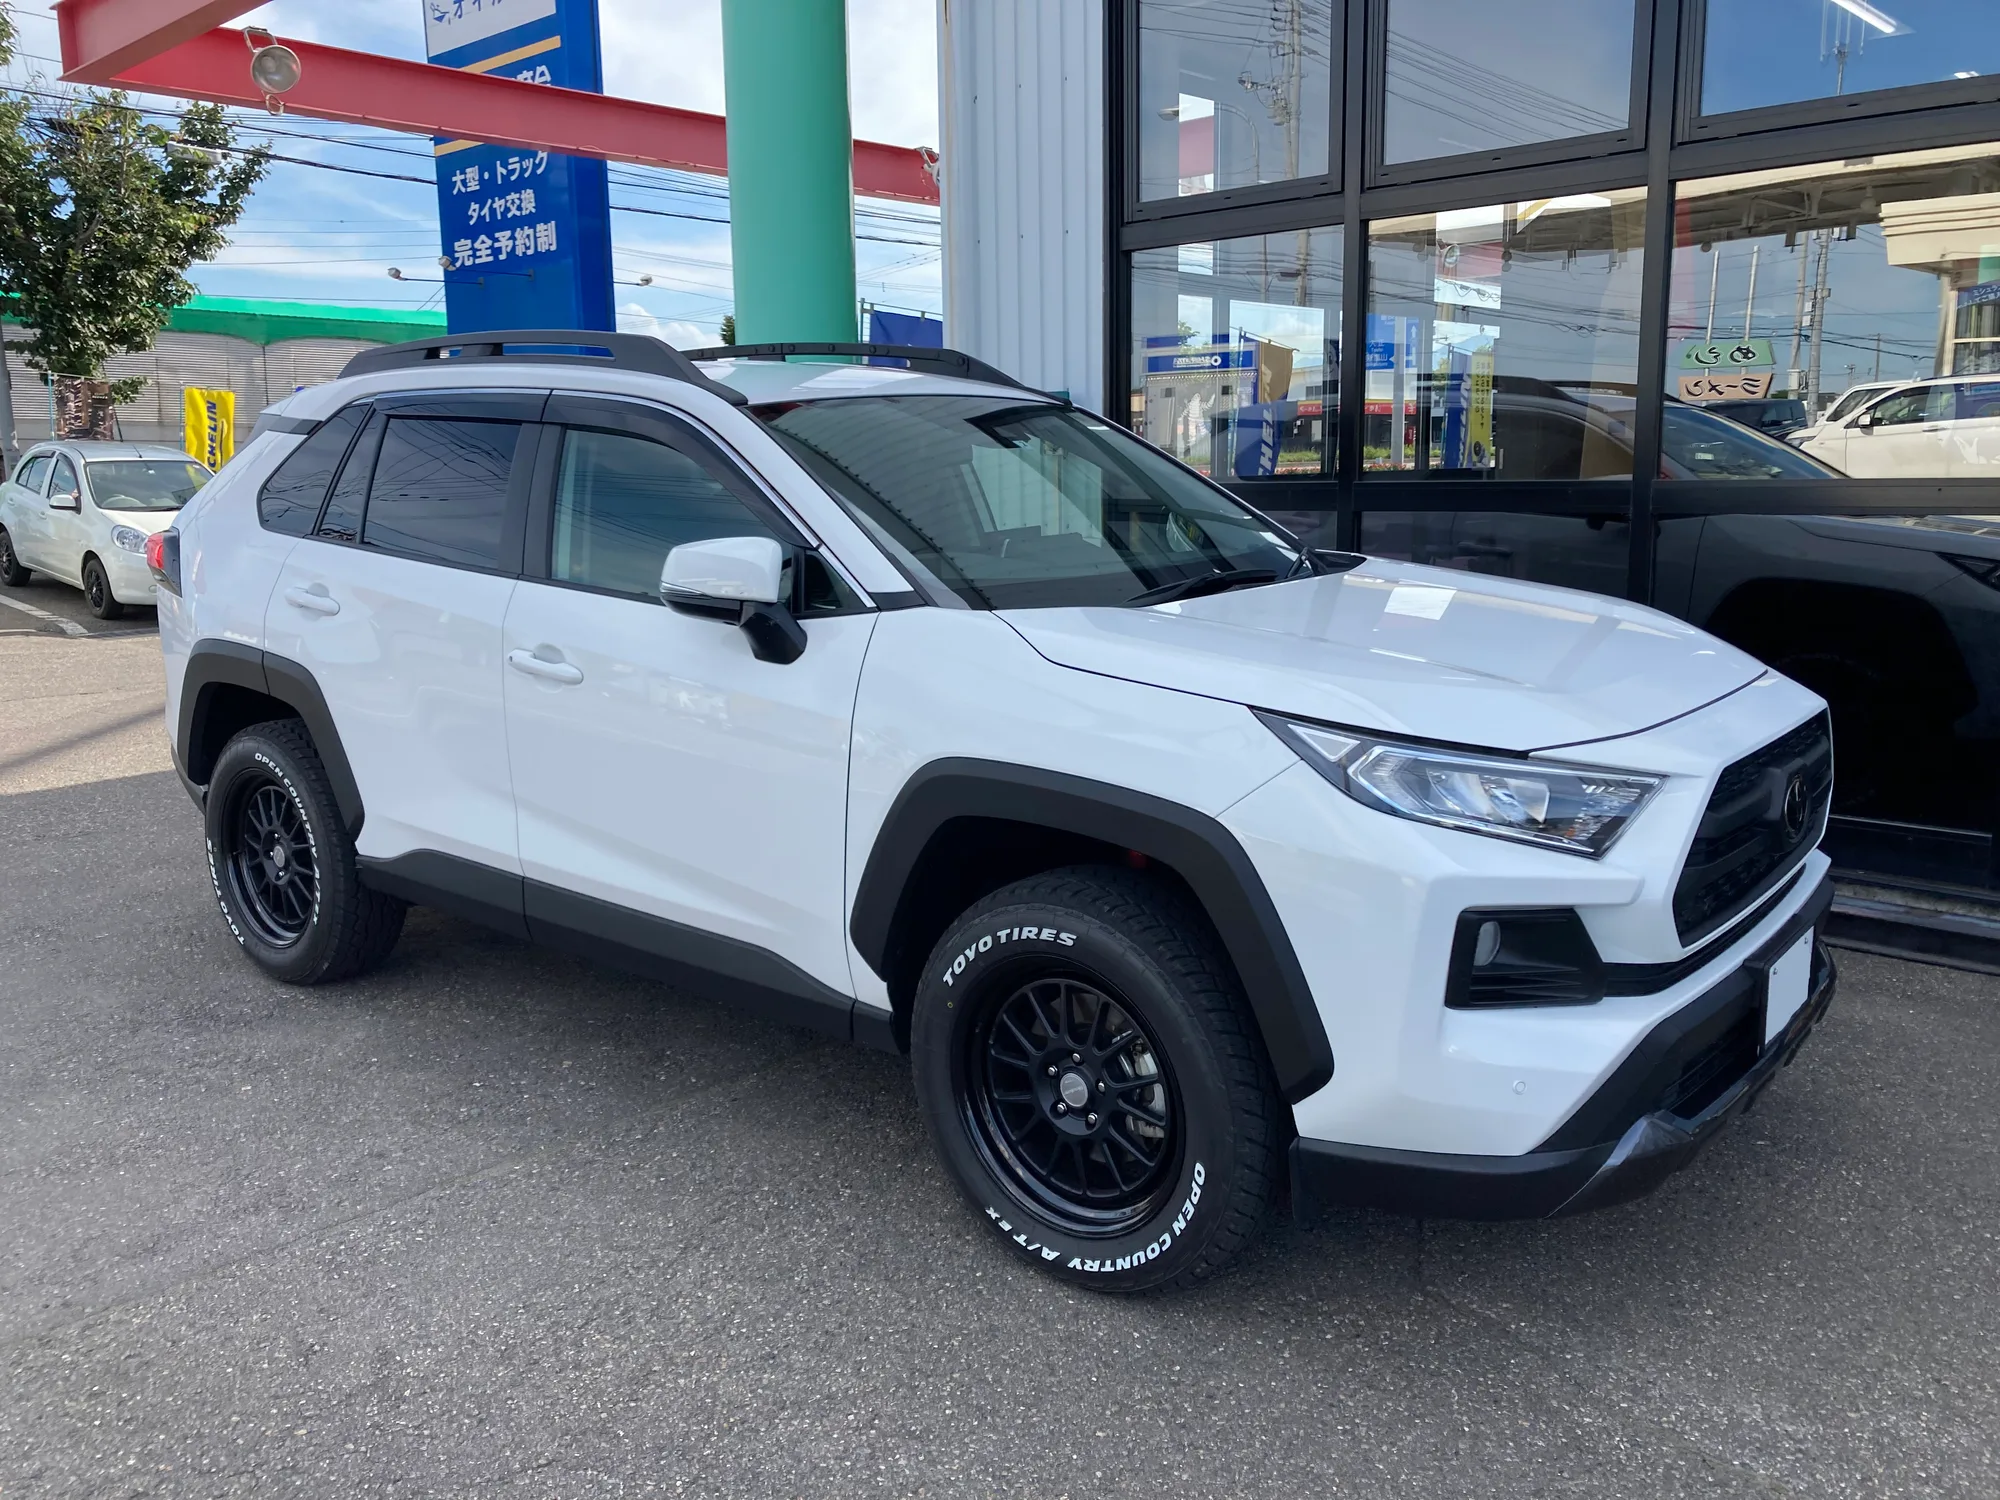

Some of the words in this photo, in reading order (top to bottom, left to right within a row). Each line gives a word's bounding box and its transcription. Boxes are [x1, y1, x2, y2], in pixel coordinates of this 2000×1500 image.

[452, 150, 548, 195] 大型・トラック
[468, 189, 536, 226] タイヤ交換
[453, 221, 557, 268] 完全予約制
[206, 400, 217, 468] CHELIN
[255, 753, 284, 778] OPEN
[283, 778, 318, 858] COUNTRY
[220, 901, 244, 945] TOYO
[942, 935, 993, 987] TOYO
[996, 926, 1077, 947] TIRES
[1171, 1162, 1206, 1236] OPEN
[1067, 1232, 1172, 1272] COUNTRY
